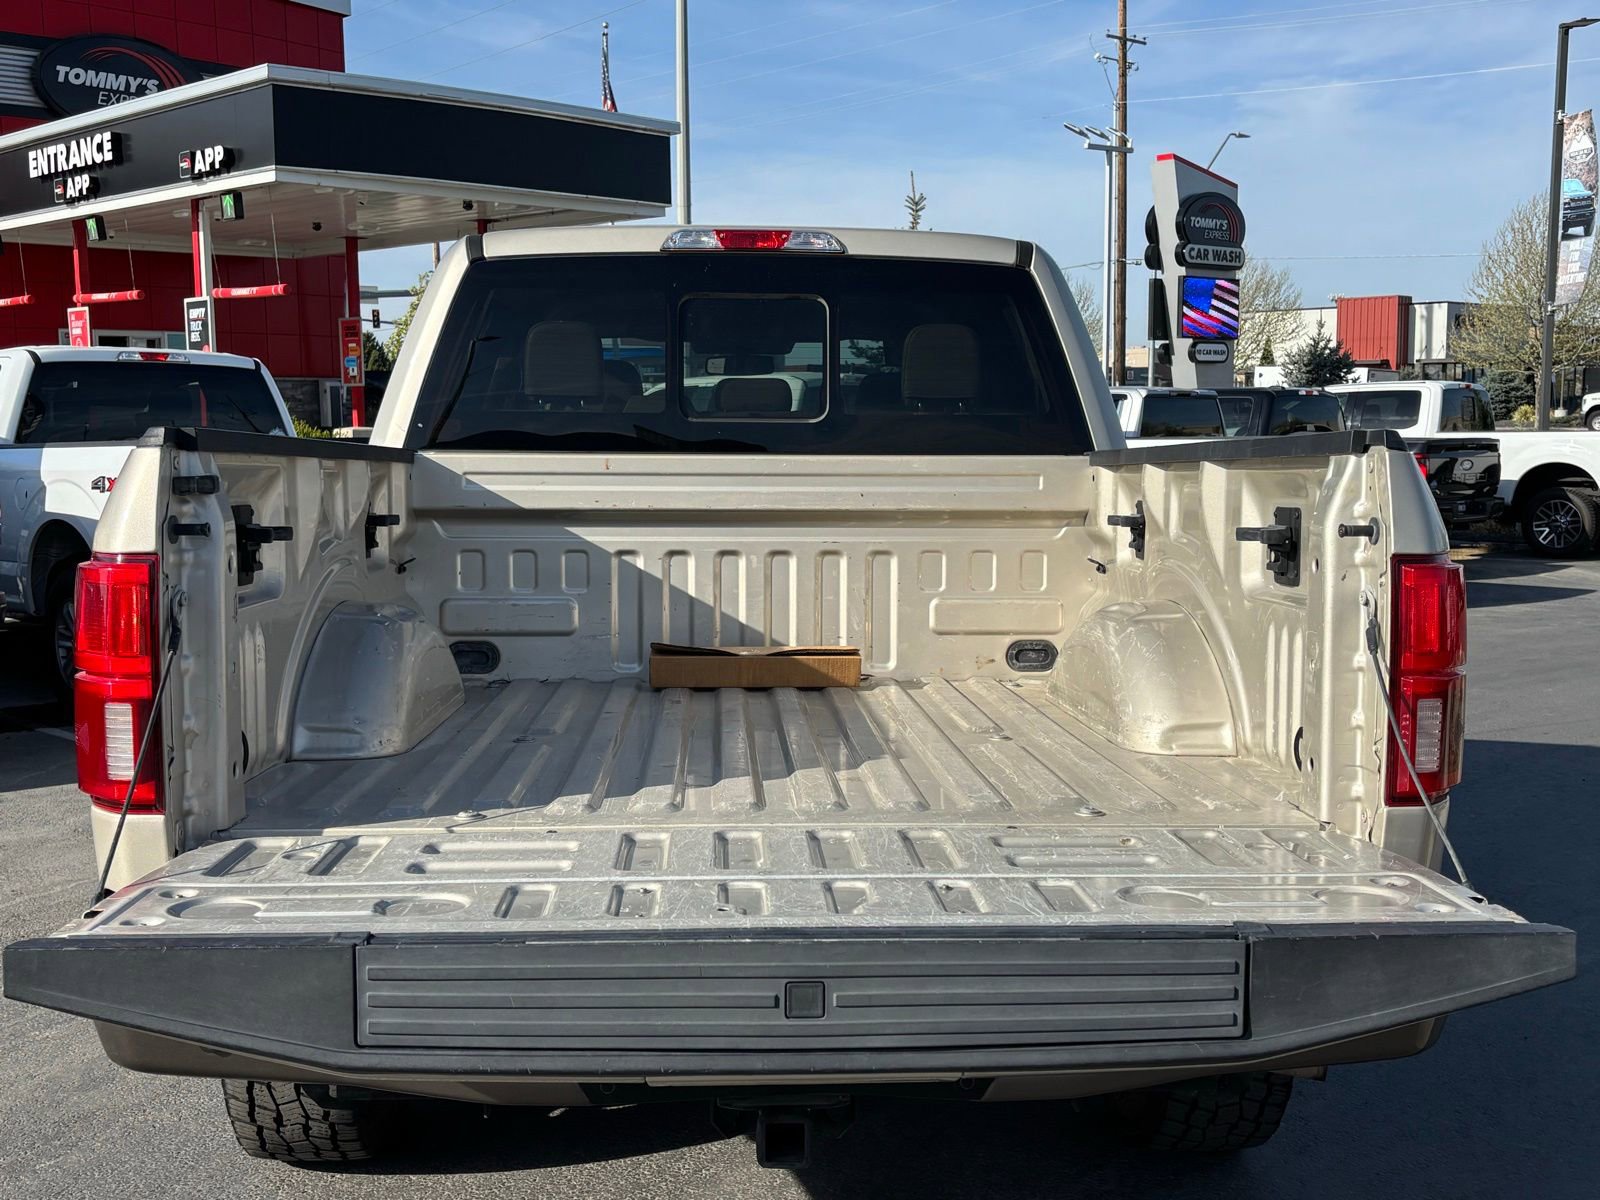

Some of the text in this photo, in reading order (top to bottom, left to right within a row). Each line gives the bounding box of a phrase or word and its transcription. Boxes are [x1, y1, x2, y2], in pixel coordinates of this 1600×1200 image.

[56, 65, 160, 94] TOMMY'S
[28, 131, 113, 178] ENTRANCE
[194, 145, 224, 174] APP
[66, 174, 90, 199] APP
[1190, 216, 1229, 230] TOMMY'S
[1204, 229, 1230, 240] EXPRESS
[1188, 247, 1241, 263] CAR WASH
